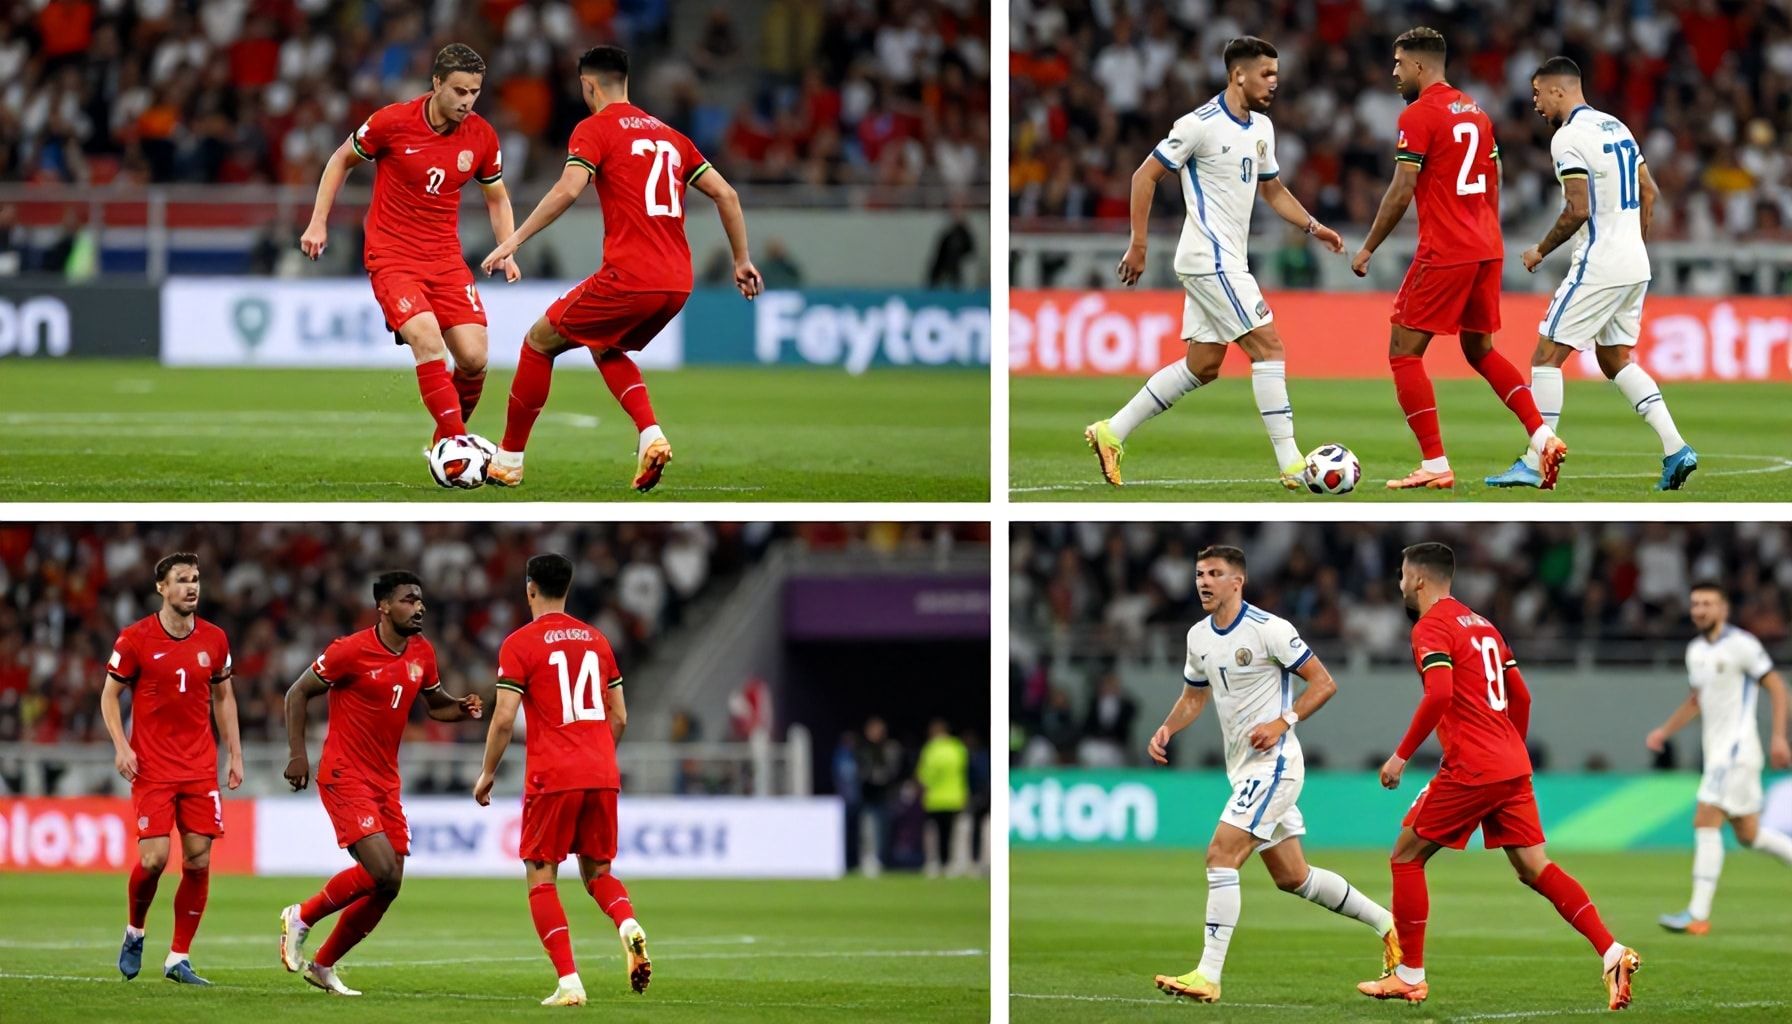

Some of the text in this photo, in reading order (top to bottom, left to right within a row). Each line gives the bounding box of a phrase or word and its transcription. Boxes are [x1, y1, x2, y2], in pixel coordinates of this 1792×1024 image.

[1453, 122, 1486, 196] 2
[755, 291, 991, 374] Feyton
[175, 668, 186, 692] 1
